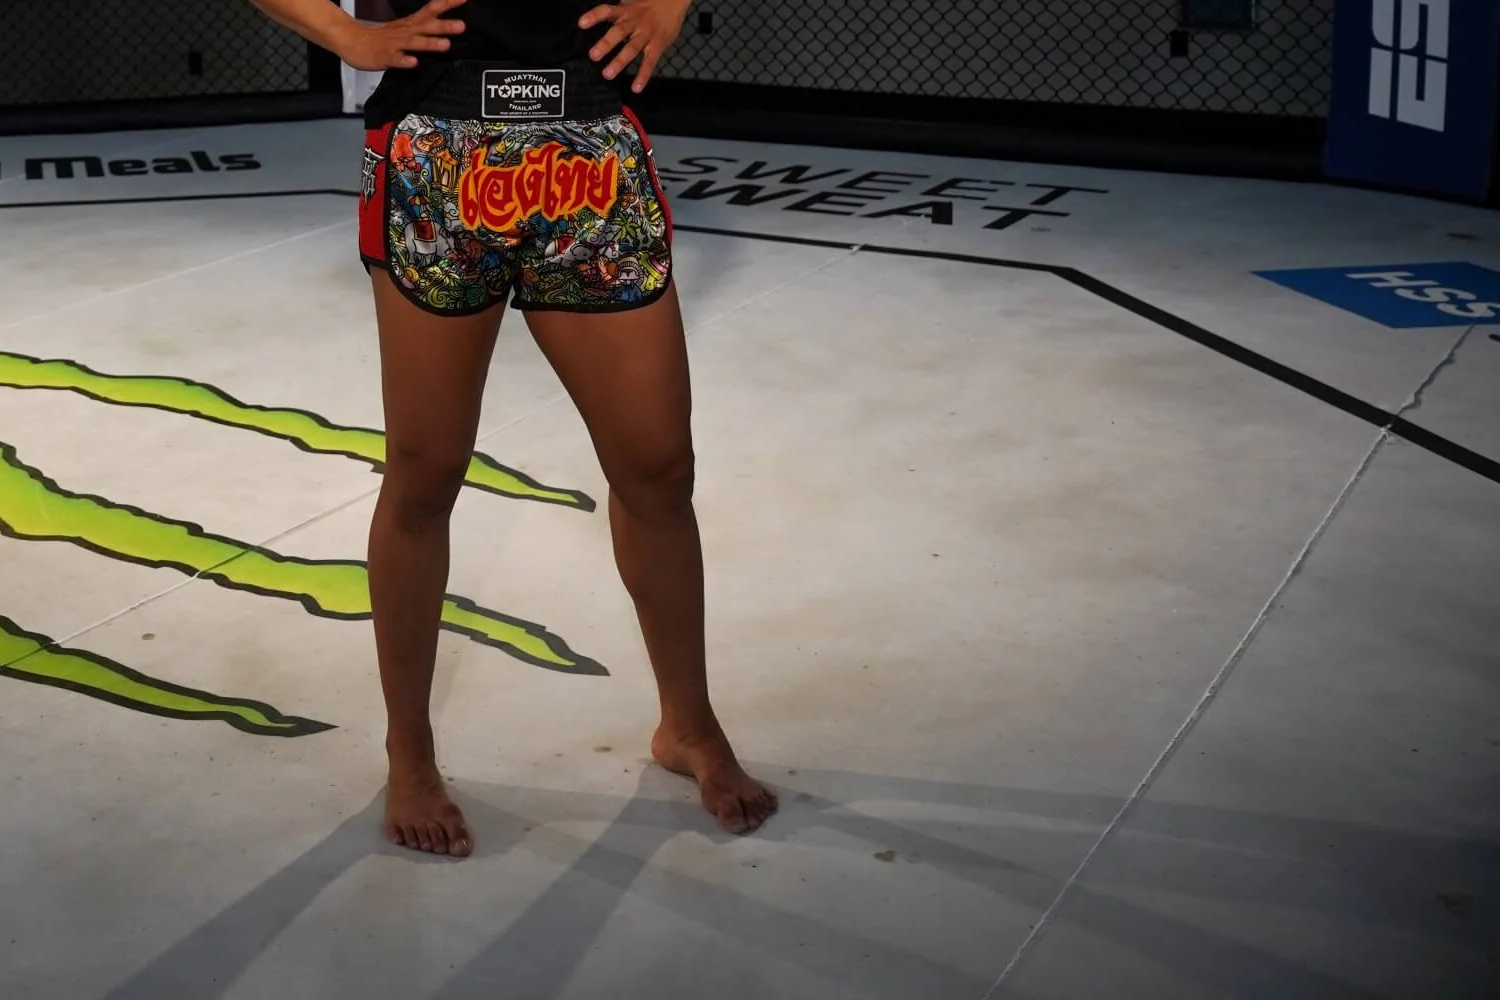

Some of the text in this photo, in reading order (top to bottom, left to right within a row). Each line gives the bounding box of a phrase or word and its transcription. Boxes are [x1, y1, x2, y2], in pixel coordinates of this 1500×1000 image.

[486, 84, 561, 98] TOPKING
[508, 103, 542, 111] THAILAND
[658, 156, 1109, 206] SWEET
[1346, 271, 1500, 318] HSS
